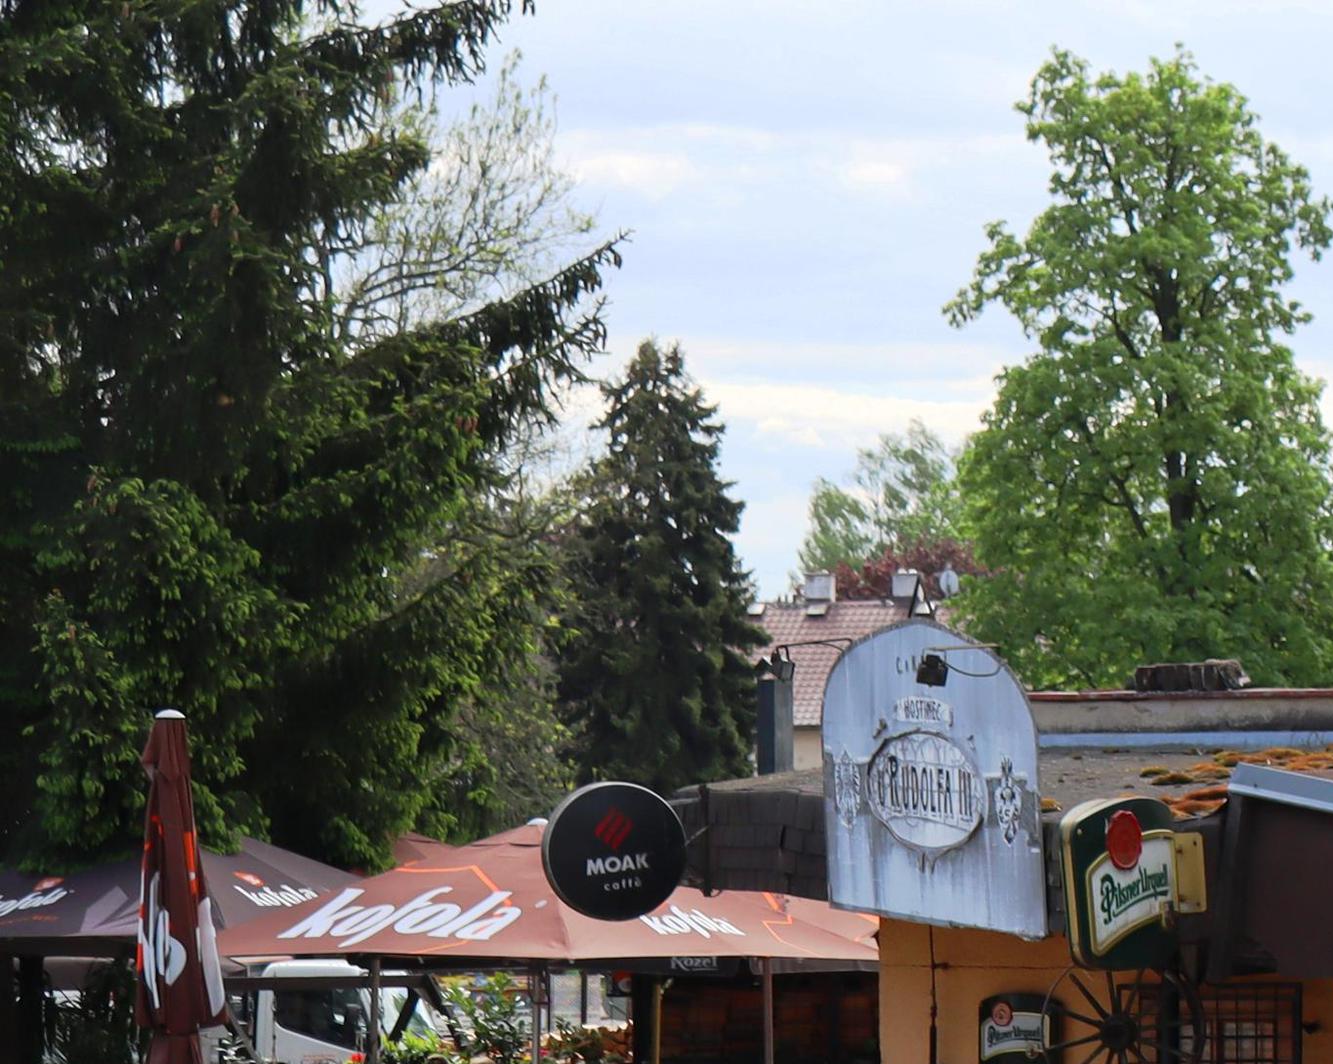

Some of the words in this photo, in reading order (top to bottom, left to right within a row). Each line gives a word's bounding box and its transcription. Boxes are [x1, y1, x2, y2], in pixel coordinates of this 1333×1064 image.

[586, 853, 650, 877] MOAK
[0, 887, 68, 917] ofola
[233, 884, 319, 908] kofola
[1101, 873, 1141, 925] Pilsner
[277, 886, 522, 949] kofola
[638, 904, 746, 939] kofola
